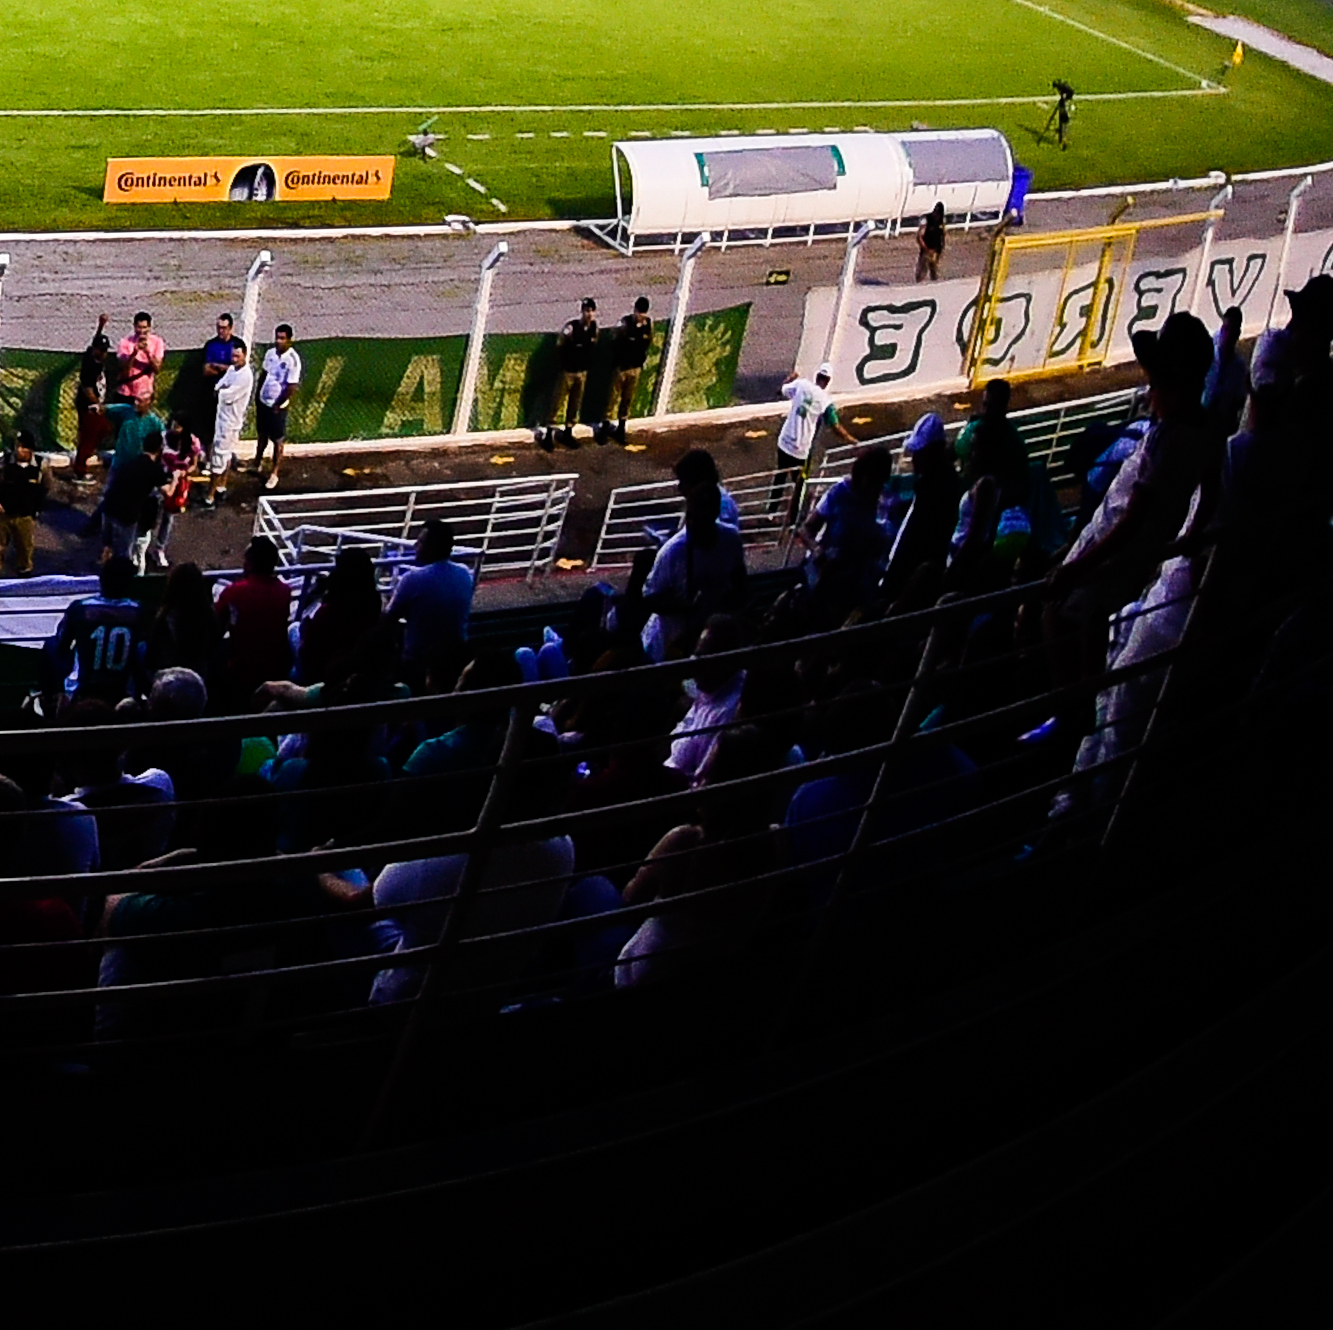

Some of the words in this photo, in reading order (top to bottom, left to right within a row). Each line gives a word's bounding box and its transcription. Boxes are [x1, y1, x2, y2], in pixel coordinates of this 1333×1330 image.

[117, 170, 208, 193] Continental
[283, 169, 370, 191] Continental
[89, 624, 132, 671] 10
